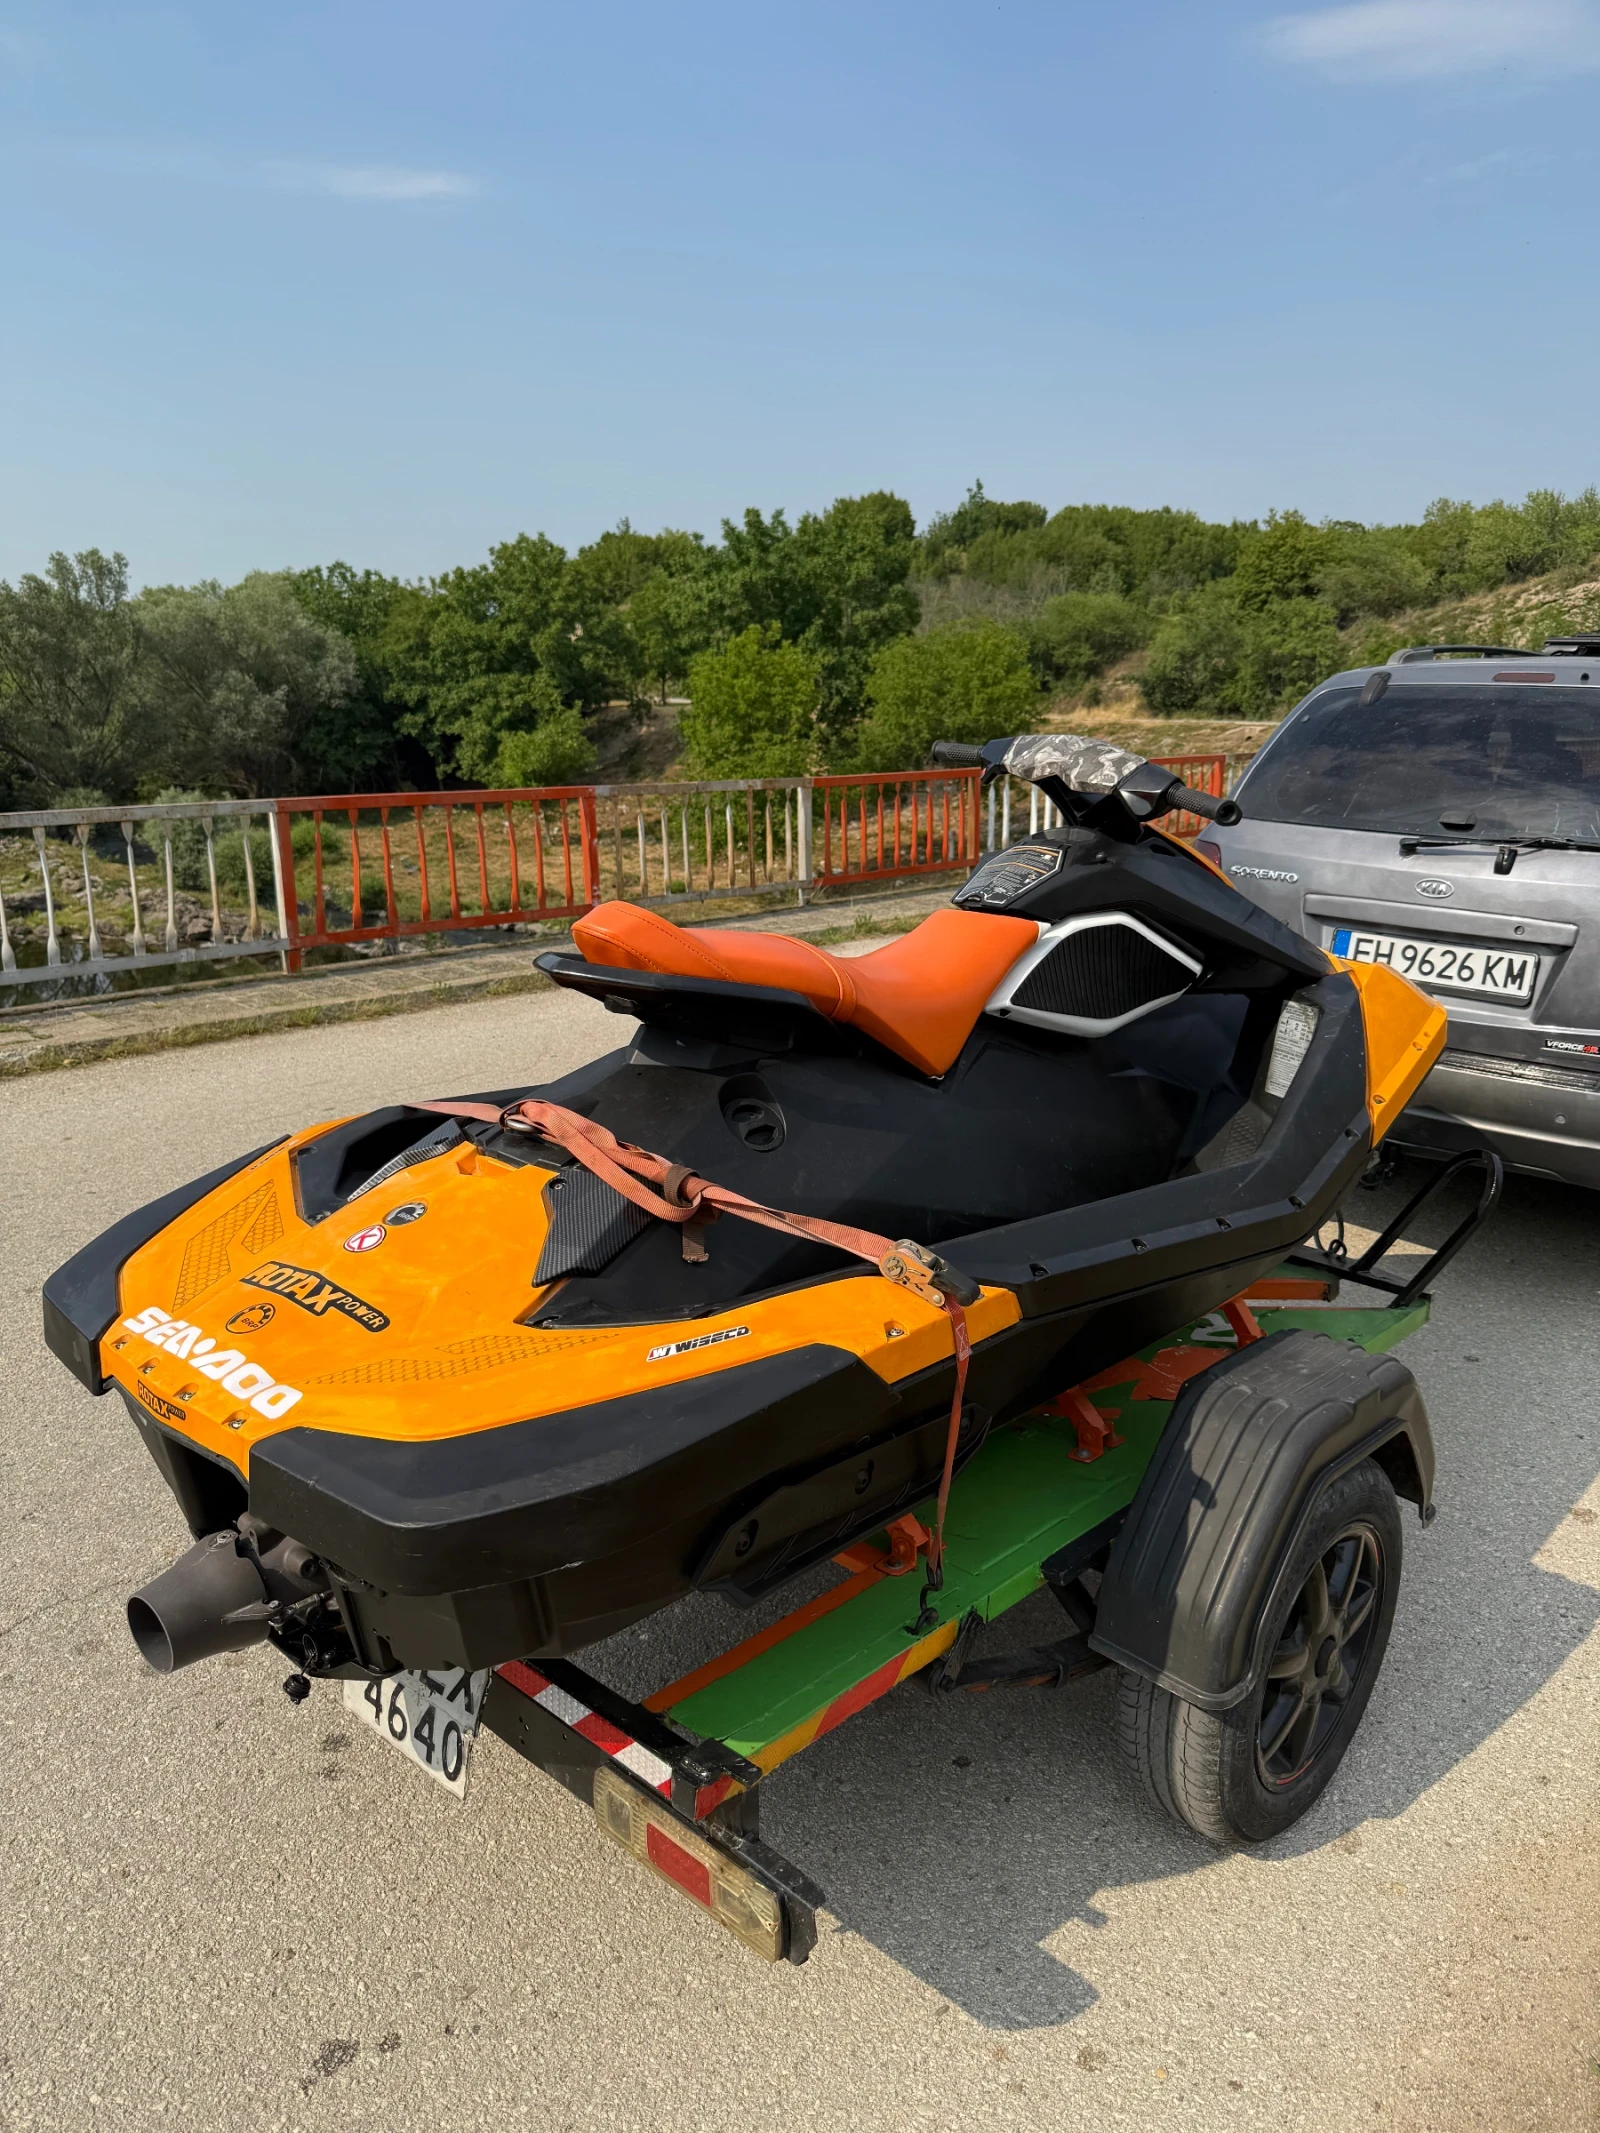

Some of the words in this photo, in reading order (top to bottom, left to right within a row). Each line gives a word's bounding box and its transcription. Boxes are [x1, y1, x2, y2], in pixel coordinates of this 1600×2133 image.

[1230, 865, 1299, 884] SORENTO
[1419, 881, 1448, 896] KIA
[1401, 944, 1475, 982] 9626
[1481, 954, 1528, 991] KM
[243, 1262, 341, 1314] ROTAX
[338, 1294, 388, 1330] POWER
[138, 1382, 169, 1418] ROTAX
[167, 1404, 185, 1419] POWER
[363, 1680, 463, 1782] 4640
